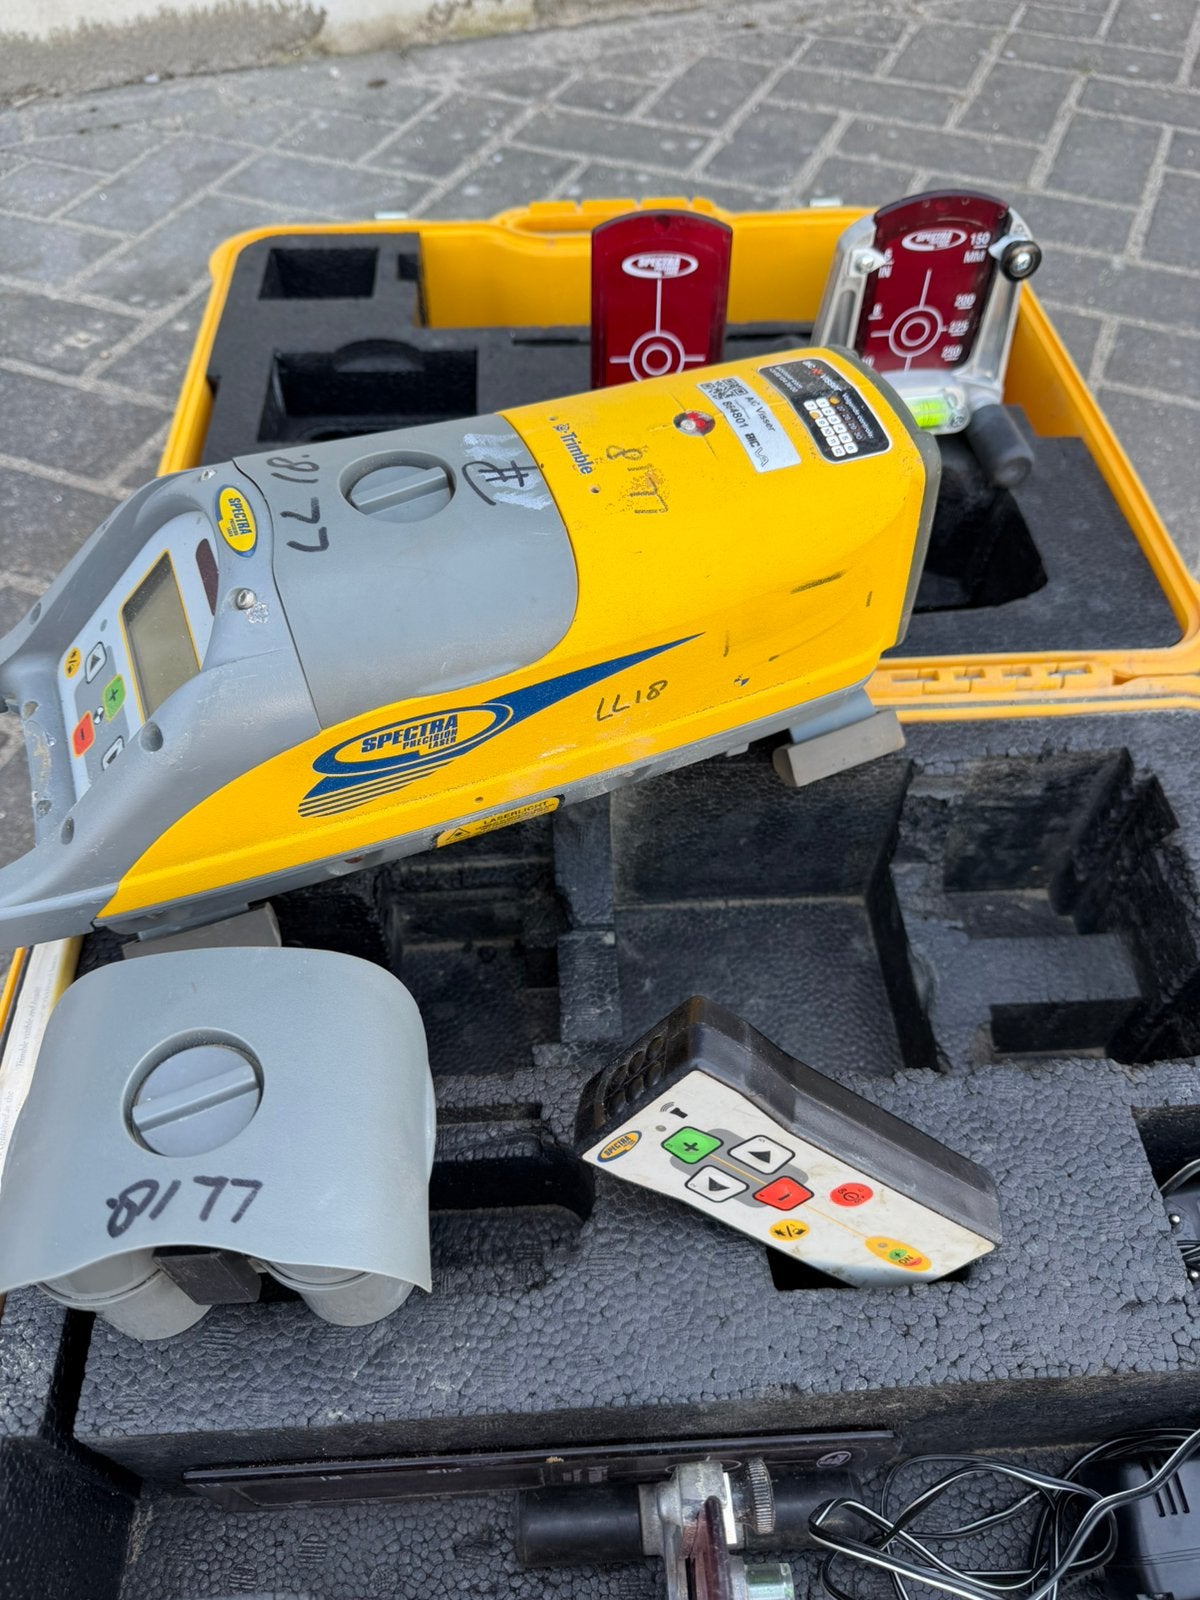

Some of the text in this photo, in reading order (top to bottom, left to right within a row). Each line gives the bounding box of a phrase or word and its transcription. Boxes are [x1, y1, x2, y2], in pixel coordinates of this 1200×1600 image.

[970, 231, 991, 246] 150
[963, 250, 986, 264] MM
[954, 292, 976, 308] 200
[756, 406, 776, 432] Visser
[560, 431, 593, 475] Trimble
[228, 497, 252, 535] SPECTRA
[361, 714, 458, 753] SPECTRA
[402, 728, 458, 750] PRECISION
[428, 736, 456, 750] LASER
[604, 1136, 631, 1156] SPECTRA
